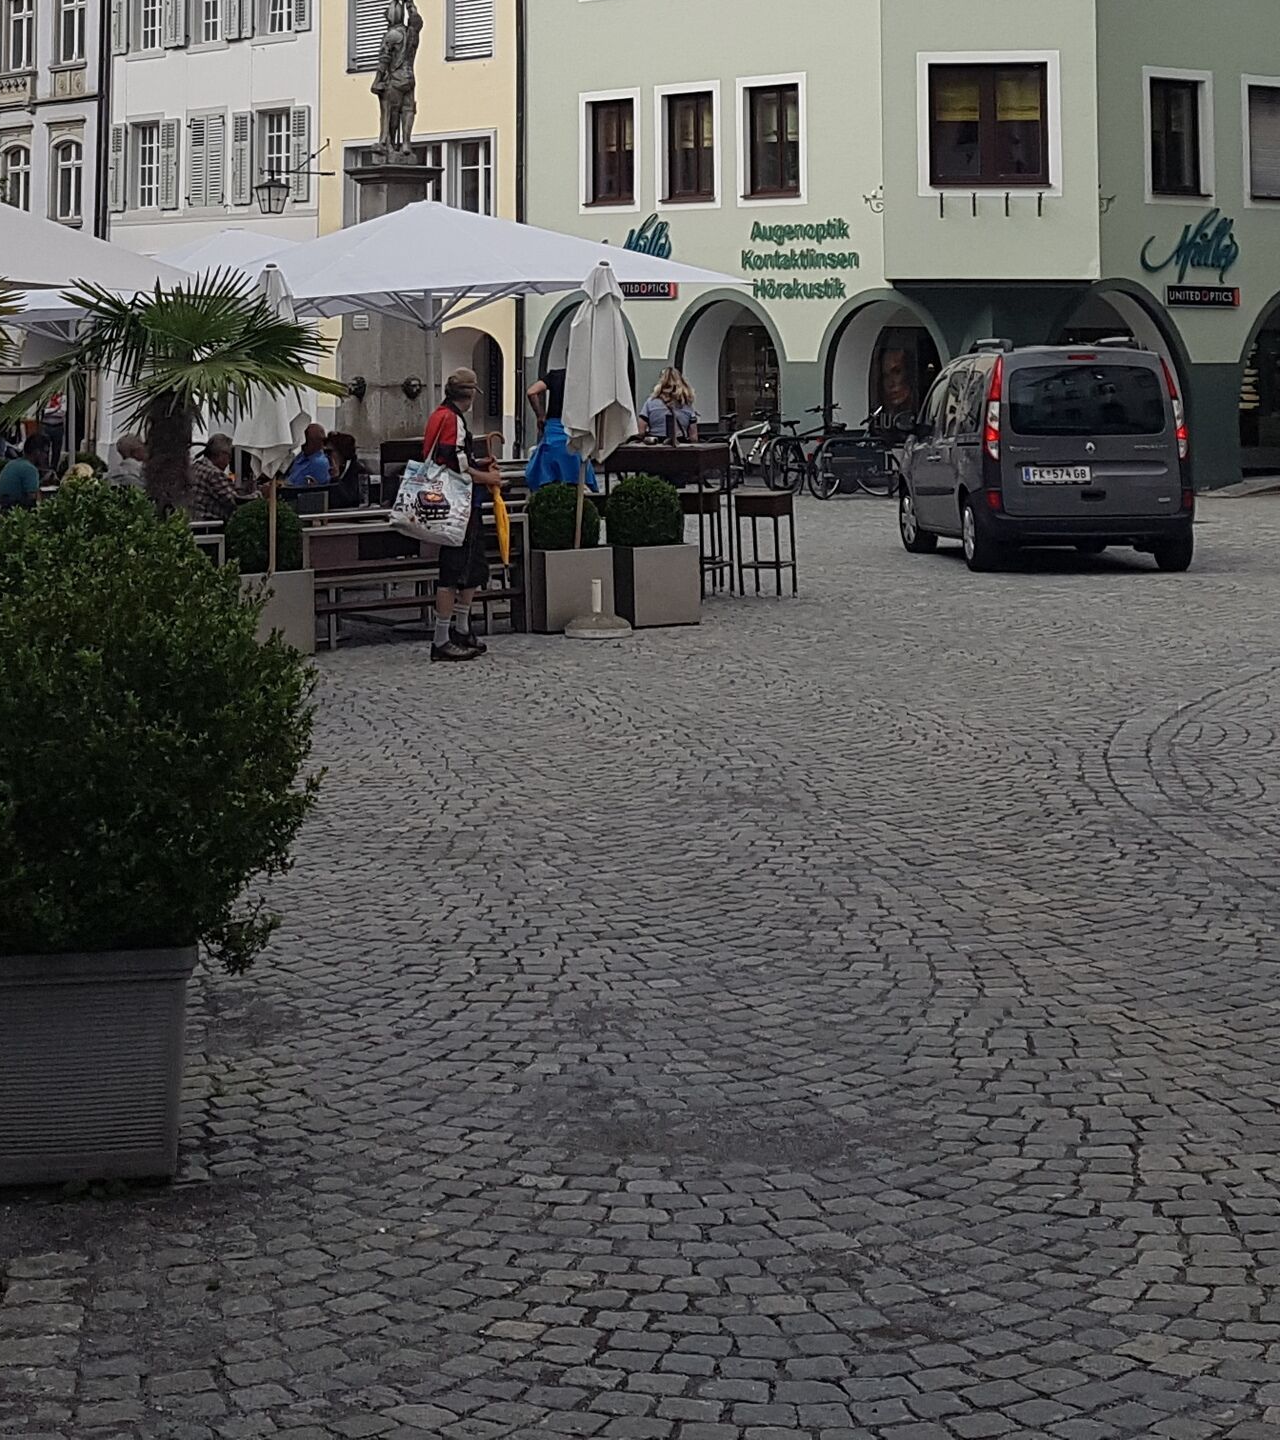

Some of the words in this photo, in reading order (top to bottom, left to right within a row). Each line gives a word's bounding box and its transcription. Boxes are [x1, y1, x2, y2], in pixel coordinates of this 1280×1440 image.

[750, 218, 850, 246] Augenoptik
[741, 248, 859, 270] Kontaktlinsen
[752, 277, 846, 300] Hörakustik
[1032, 468, 1045, 479] FK
[1052, 468, 1071, 479] 574
